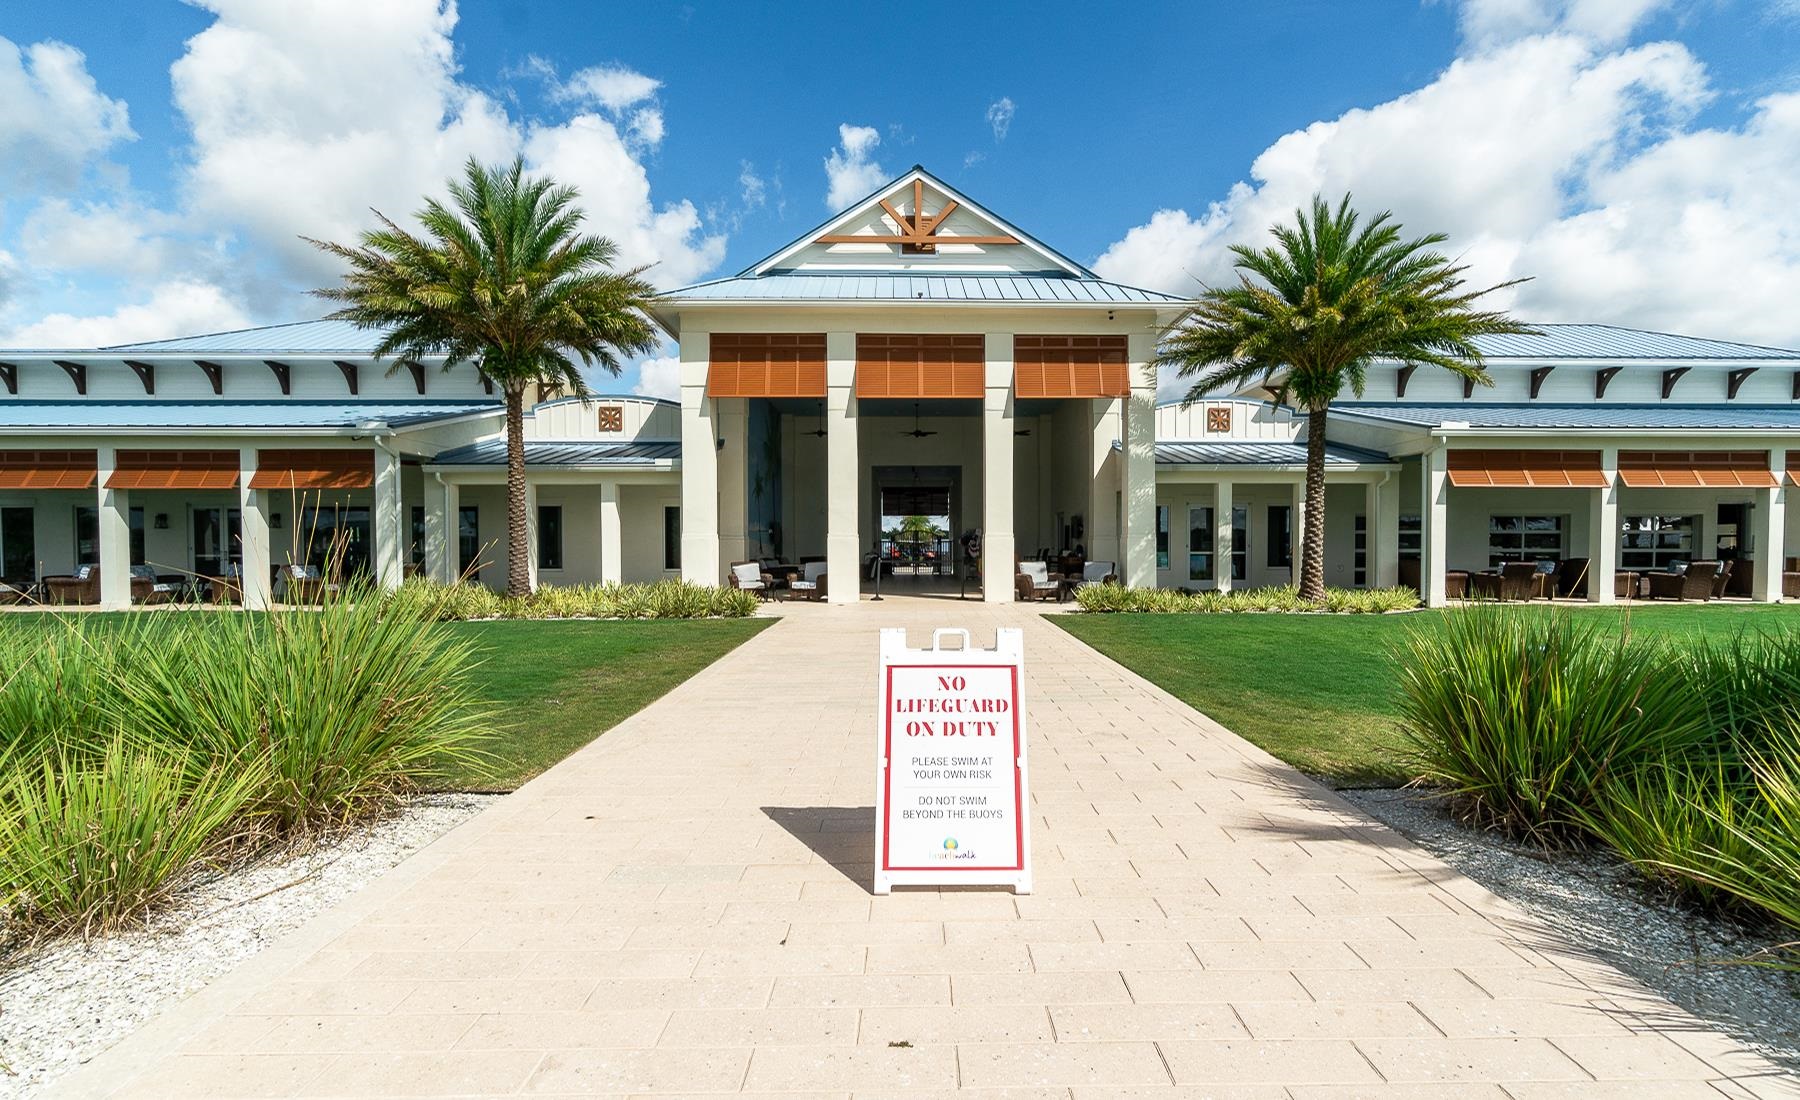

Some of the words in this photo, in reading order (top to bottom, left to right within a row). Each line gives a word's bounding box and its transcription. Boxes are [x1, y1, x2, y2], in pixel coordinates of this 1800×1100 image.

[938, 676, 966, 690] NO
[896, 699, 1009, 713] LIFEGUARD
[906, 722, 935, 736] ON
[943, 722, 999, 736] DUTY
[912, 757, 948, 766] PLEASE
[951, 757, 978, 766] SWIM
[981, 757, 993, 766] AT
[914, 770, 940, 779] YOUR
[944, 770, 966, 779] OWN
[970, 770, 992, 779] RISK
[919, 796, 932, 805] DO
[936, 796, 956, 805] NOT
[960, 796, 987, 805] SWIM
[903, 810, 944, 819] BEYOND
[947, 810, 966, 819] THE
[969, 810, 1003, 819] BUOYS
